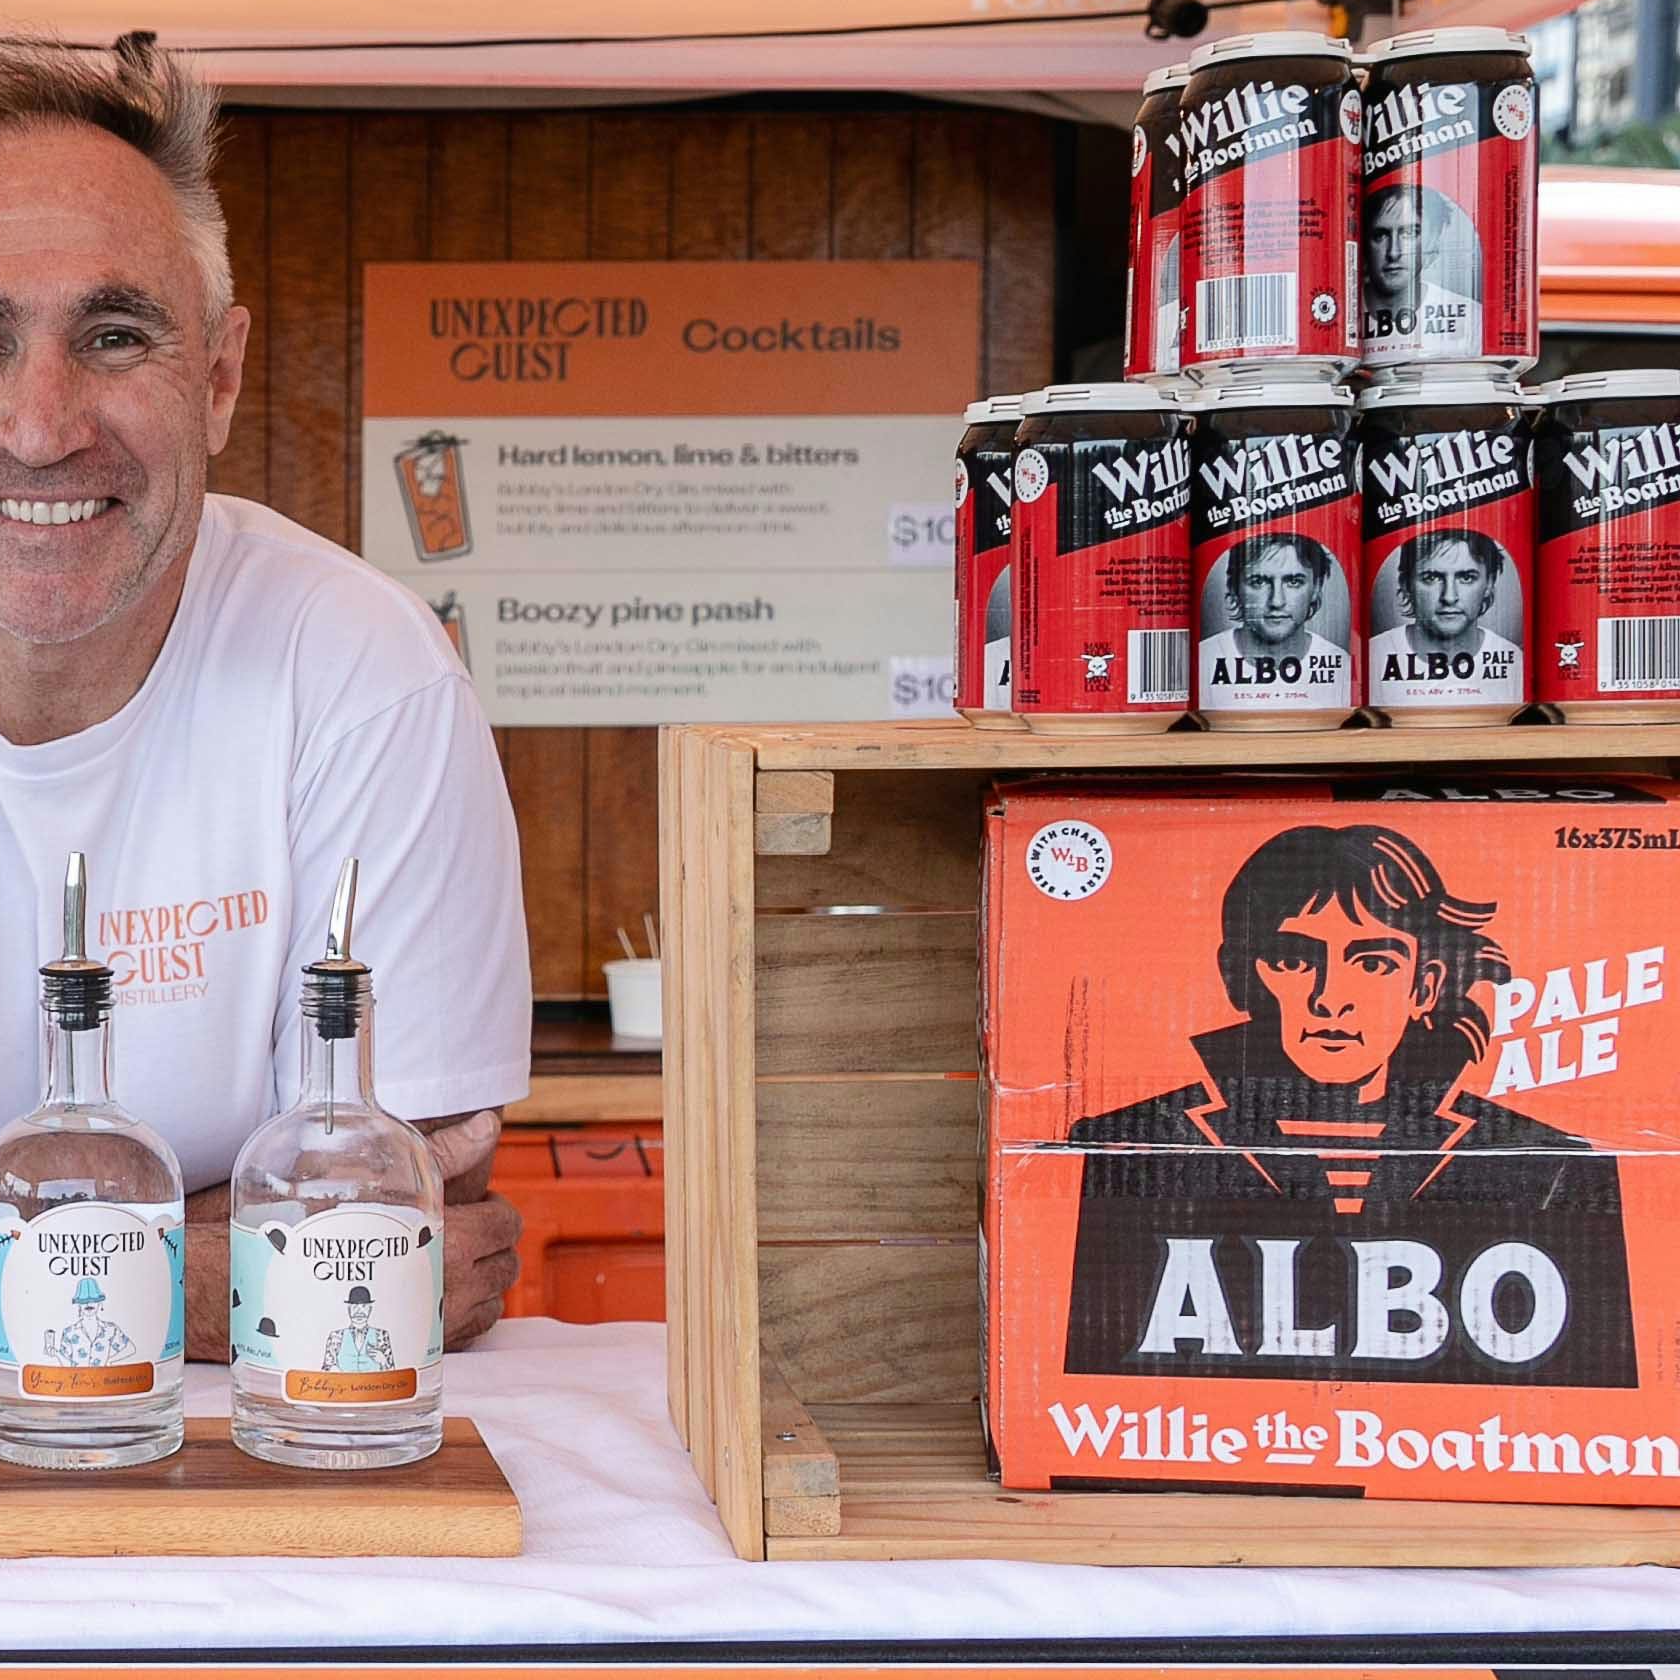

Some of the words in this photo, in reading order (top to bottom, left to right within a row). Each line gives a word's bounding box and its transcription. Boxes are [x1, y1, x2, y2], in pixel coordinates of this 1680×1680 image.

[1180, 80, 1311, 156] Willie
[1363, 81, 1467, 149] illie
[1197, 117, 1319, 176] Boatman
[429, 296, 648, 338] UNEXPECTED
[1363, 303, 1418, 341] LBO
[1423, 303, 1467, 321] PALE
[1423, 319, 1457, 336] ALE
[681, 317, 902, 353] Cocktails
[449, 342, 572, 383] GUEST
[497, 444, 567, 466] Hard
[571, 445, 668, 467] lemon,
[672, 444, 734, 466] lime
[739, 444, 760, 466] &
[765, 443, 860, 466] bitters
[1198, 432, 1343, 501] Willie
[1369, 429, 1515, 498] Willie
[1207, 504, 1232, 528] the
[1229, 473, 1347, 523] Boatman
[1377, 501, 1403, 525] the
[1400, 469, 1521, 520] Boatman
[1573, 495, 1602, 519] the
[1104, 506, 1134, 530] the
[496, 597, 603, 629] Boozy
[610, 596, 683, 629] pine
[691, 596, 775, 627] pash
[1209, 655, 1304, 686] ALBO
[1308, 654, 1343, 669] PALE
[1381, 652, 1475, 683] ALBO
[1481, 650, 1516, 666] PALE
[1481, 665, 1509, 680] ALE
[1308, 669, 1336, 685] ALE
[1379, 785, 1618, 803] ALBO
[1030, 829, 1058, 861] WITH
[99, 888, 269, 947] UNEXPECTED
[107, 941, 206, 986] GUEST
[115, 981, 210, 1009] ISTILLERY
[1492, 945, 1666, 1037] PALE
[1486, 1016, 1621, 1098] ALE
[37, 1230, 146, 1256] UNEXPECTED
[301, 1236, 410, 1260] UNEXPECTED
[48, 1255, 112, 1277] GUEST
[312, 1260, 377, 1283] GUEST
[1137, 1237, 1568, 1364] ALBO
[1047, 1401, 1249, 1466] Willie
[1253, 1411, 1329, 1466] the
[1333, 1408, 1680, 1479] Boatman
